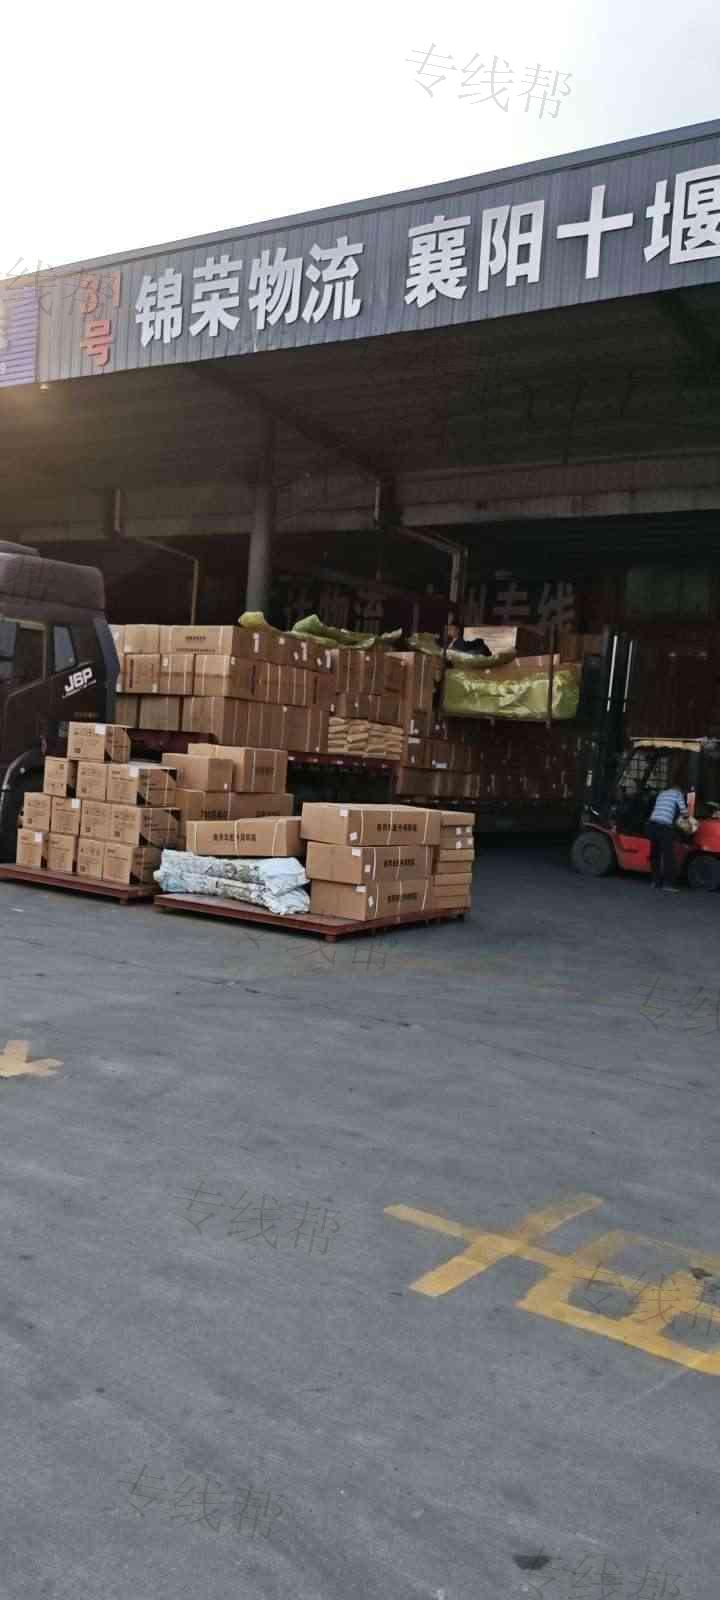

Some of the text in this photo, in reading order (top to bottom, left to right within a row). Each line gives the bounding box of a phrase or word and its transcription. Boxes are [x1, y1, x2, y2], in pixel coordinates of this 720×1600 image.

[135, 164, 720, 347] 锦荣物流 襄阳十堰
